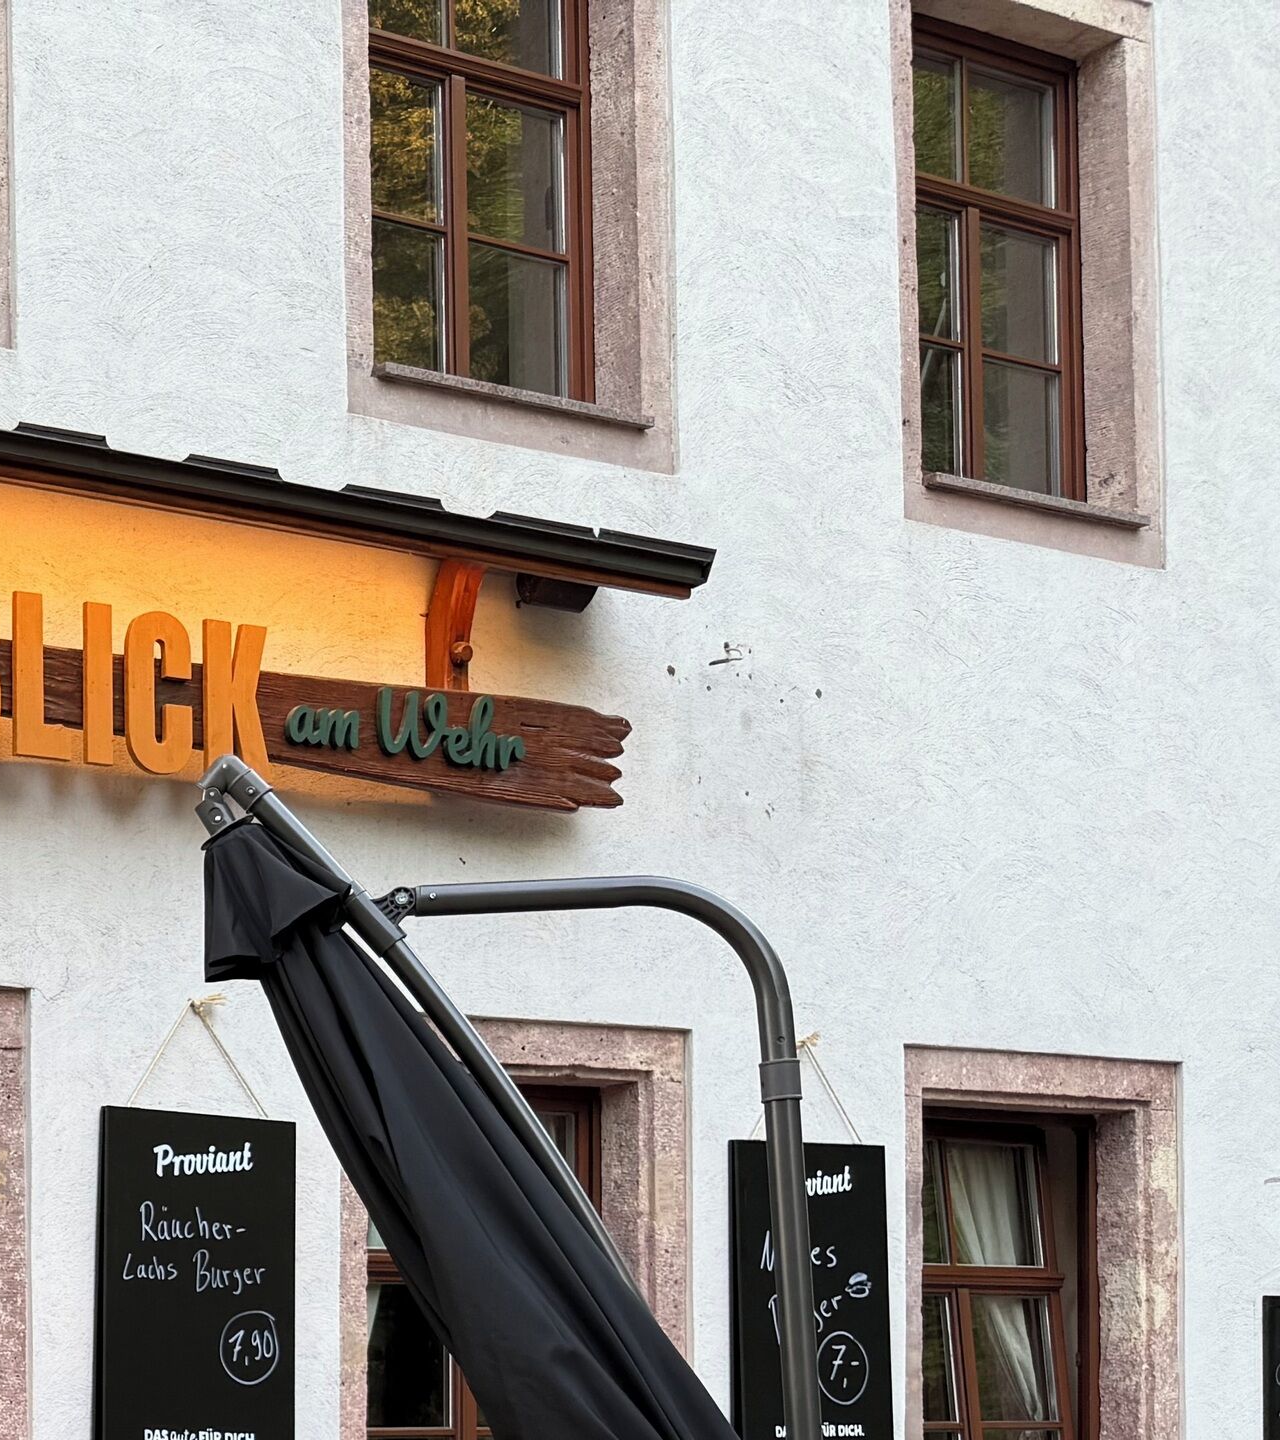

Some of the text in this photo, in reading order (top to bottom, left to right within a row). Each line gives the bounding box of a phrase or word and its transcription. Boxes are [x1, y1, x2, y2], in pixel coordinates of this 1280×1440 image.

[285, 704, 360, 750] am
[376, 686, 526, 771] Wehr
[153, 1142, 253, 1177] Proviant
[805, 1165, 853, 1196] viant
[139, 1201, 247, 1242] Räucher-
[122, 1249, 267, 1295] Lachs Burger
[228, 1327, 274, 1367] 7,90
[821, 1421, 836, 1437] ÜR
[837, 1424, 865, 1437] DICH.
